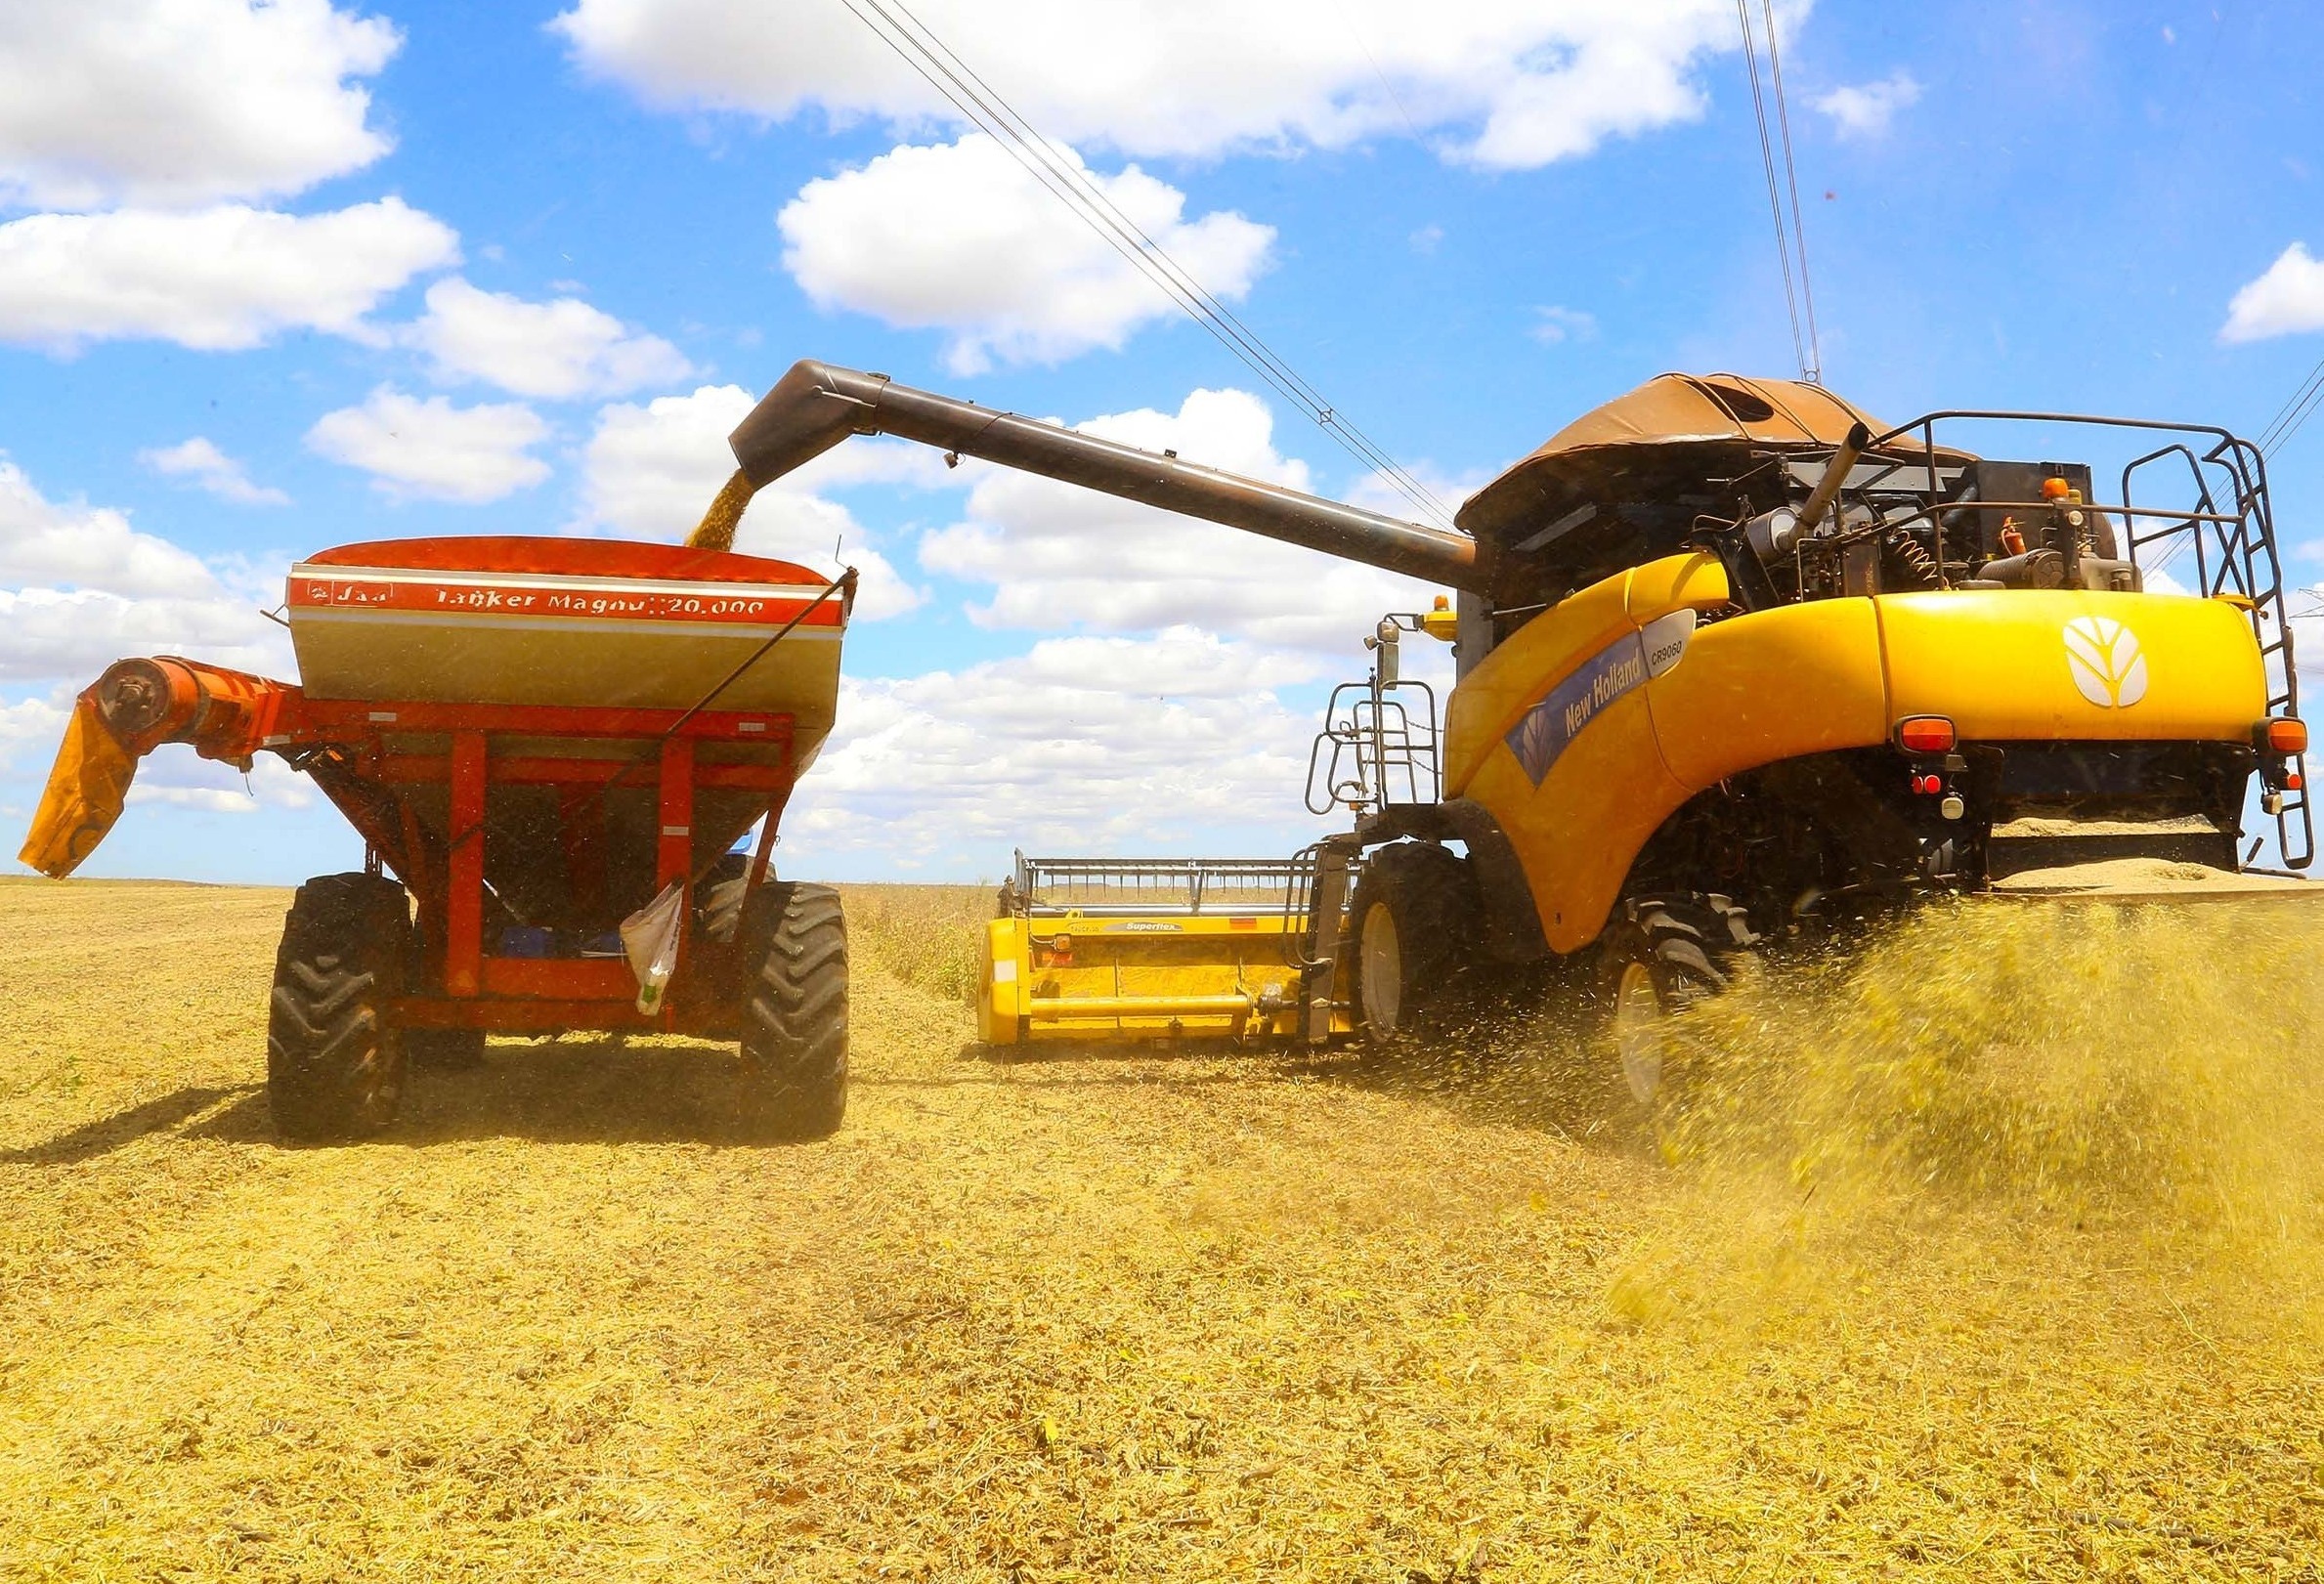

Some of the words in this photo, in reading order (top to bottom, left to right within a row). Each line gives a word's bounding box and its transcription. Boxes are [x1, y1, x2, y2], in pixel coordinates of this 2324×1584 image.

[1652, 640, 1683, 665] CR9060
[1566, 693, 1591, 738] New
[1593, 646, 1642, 708] Holland
[1126, 921, 1177, 931] Superflex
